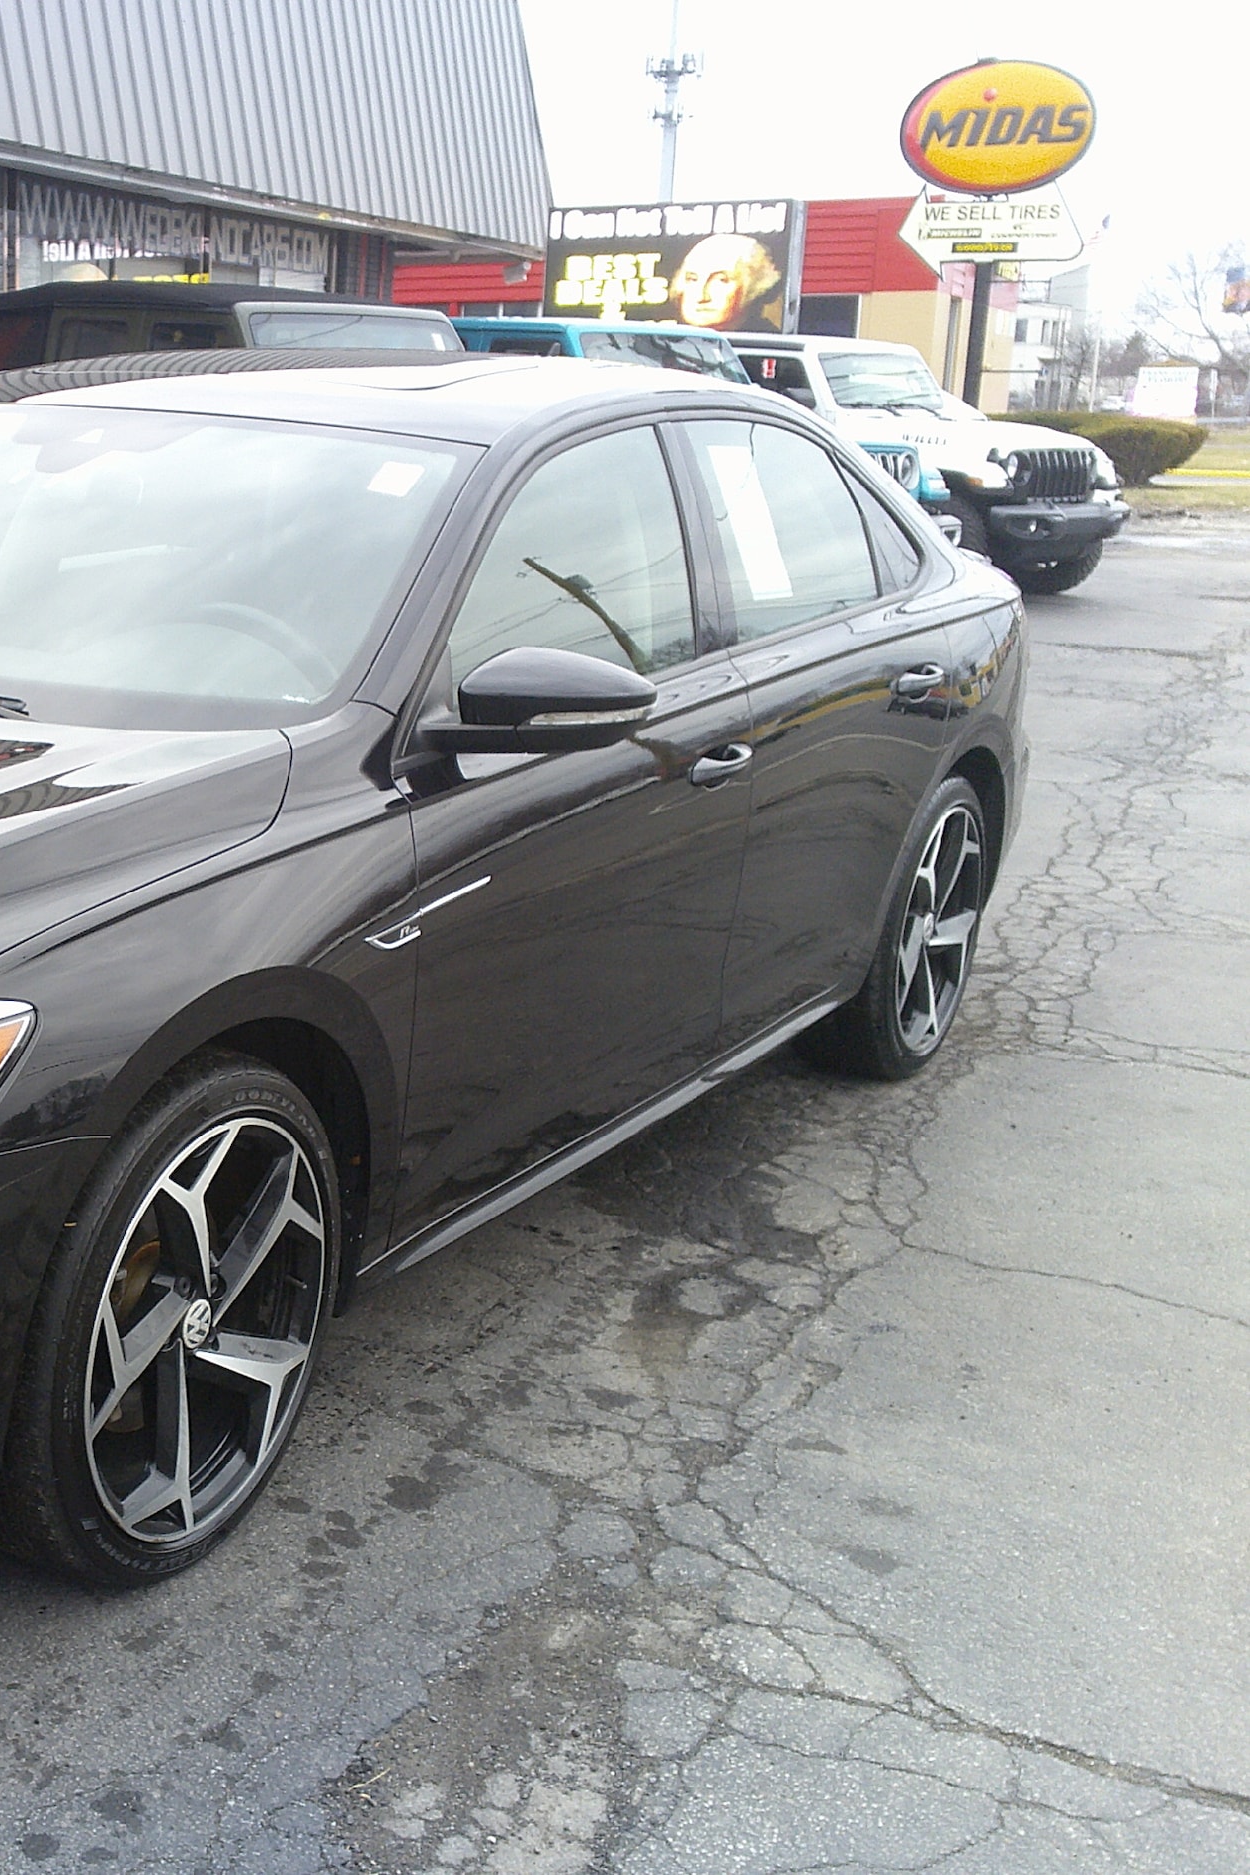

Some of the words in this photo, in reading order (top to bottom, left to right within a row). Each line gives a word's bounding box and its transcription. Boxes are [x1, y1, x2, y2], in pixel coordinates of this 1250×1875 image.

[920, 102, 1089, 153] MIDAS
[925, 205, 951, 222] WE
[957, 205, 1002, 222] SELL
[1009, 204, 1061, 220] TIRES
[564, 253, 662, 282] BEST
[554, 277, 669, 307] DEALS
